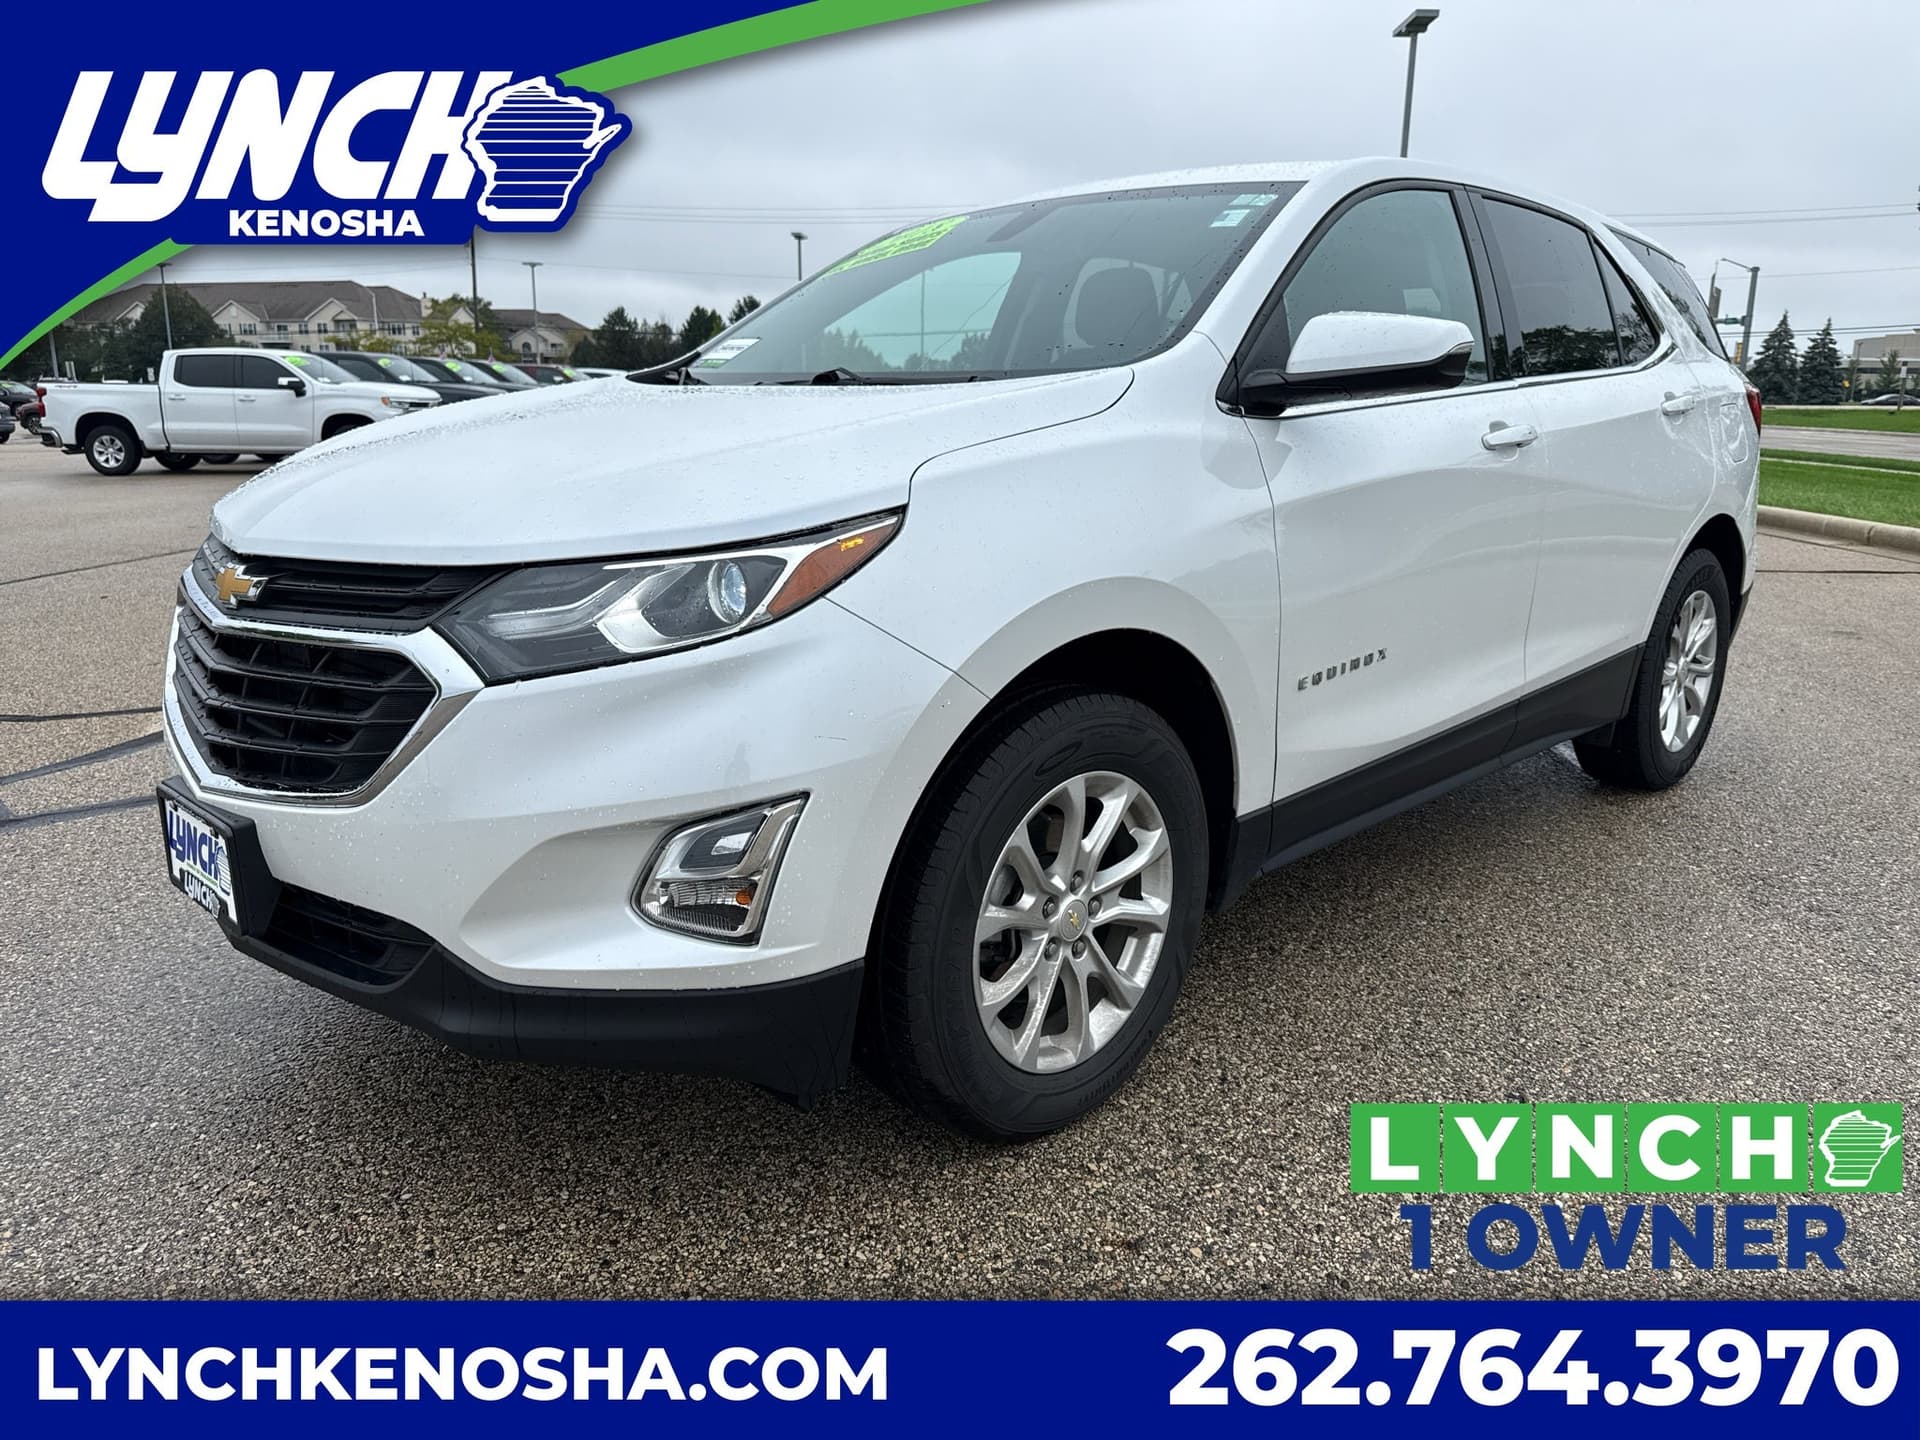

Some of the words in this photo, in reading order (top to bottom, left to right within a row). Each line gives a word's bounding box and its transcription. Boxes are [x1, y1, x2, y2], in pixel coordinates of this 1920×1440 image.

[1298, 648, 1387, 691] EQUINOX
[168, 810, 219, 880] LYNCH
[184, 870, 213, 911] LYNCH
